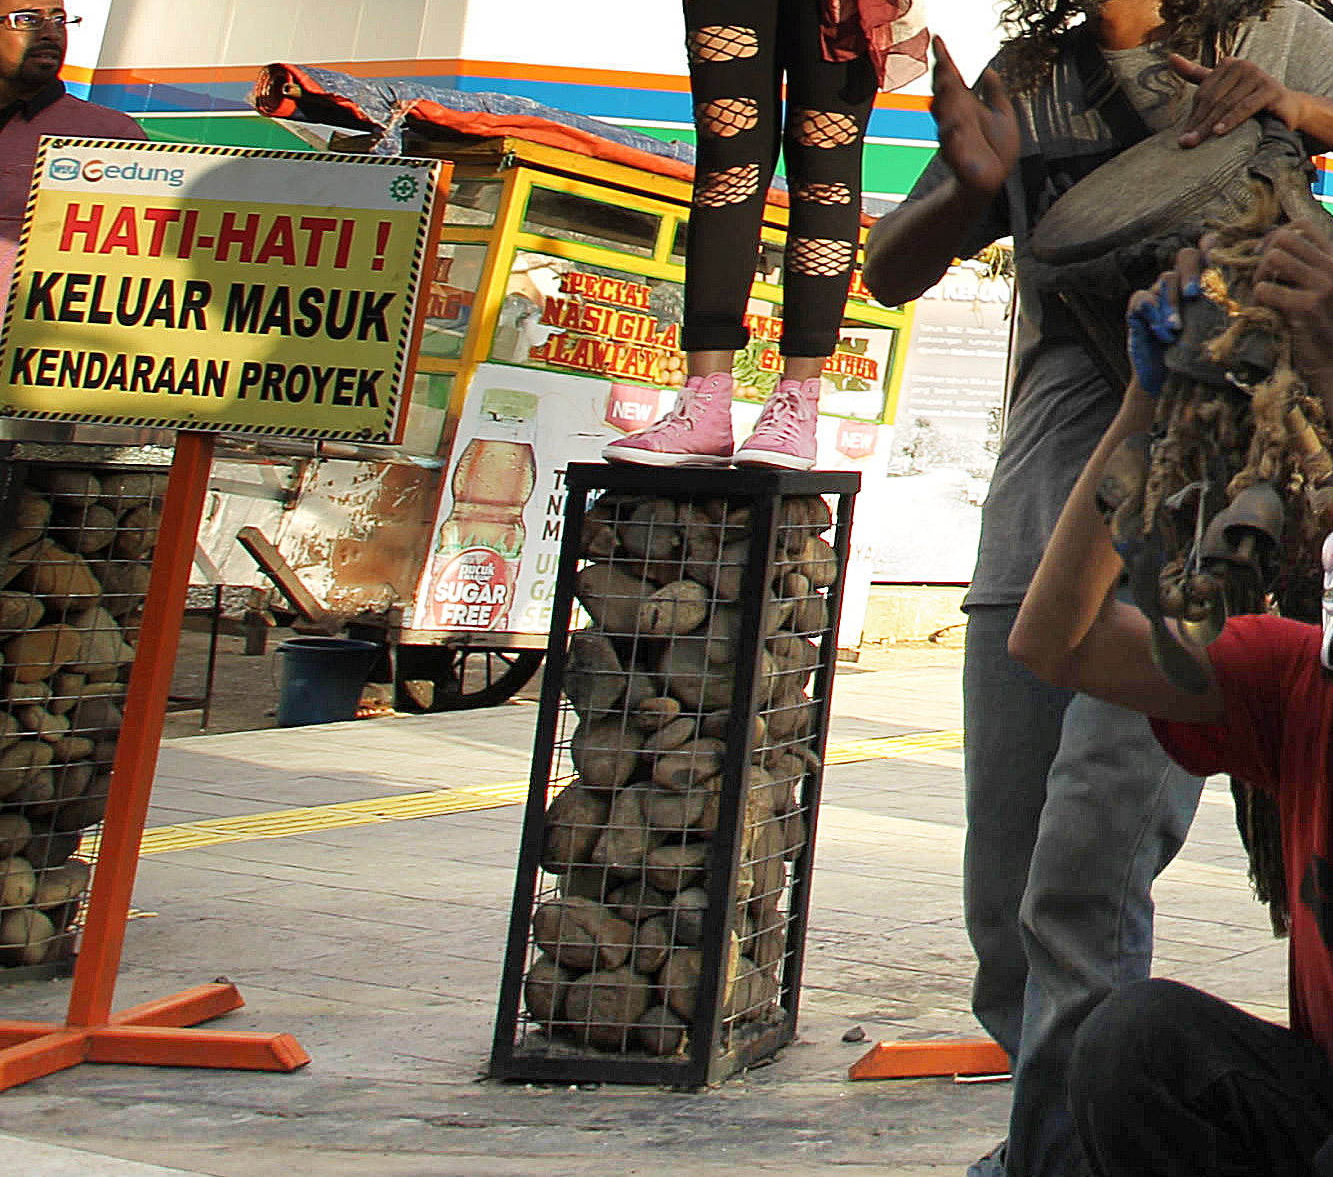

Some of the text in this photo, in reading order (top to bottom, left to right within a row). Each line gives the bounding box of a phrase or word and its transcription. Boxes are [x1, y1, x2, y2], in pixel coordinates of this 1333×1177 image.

[82, 160, 184, 187] Gedung
[59, 203, 355, 270] HATI-HATI
[372, 222, 392, 271] !
[24, 271, 212, 331] KELUAR
[222, 283, 397, 342] MASUK
[9, 347, 385, 408] KENDARAAN PROYEK
[612, 400, 653, 421] NEW
[840, 430, 875, 449] NEW
[434, 582, 508, 604] SUGAR
[440, 603, 493, 626] FREE
